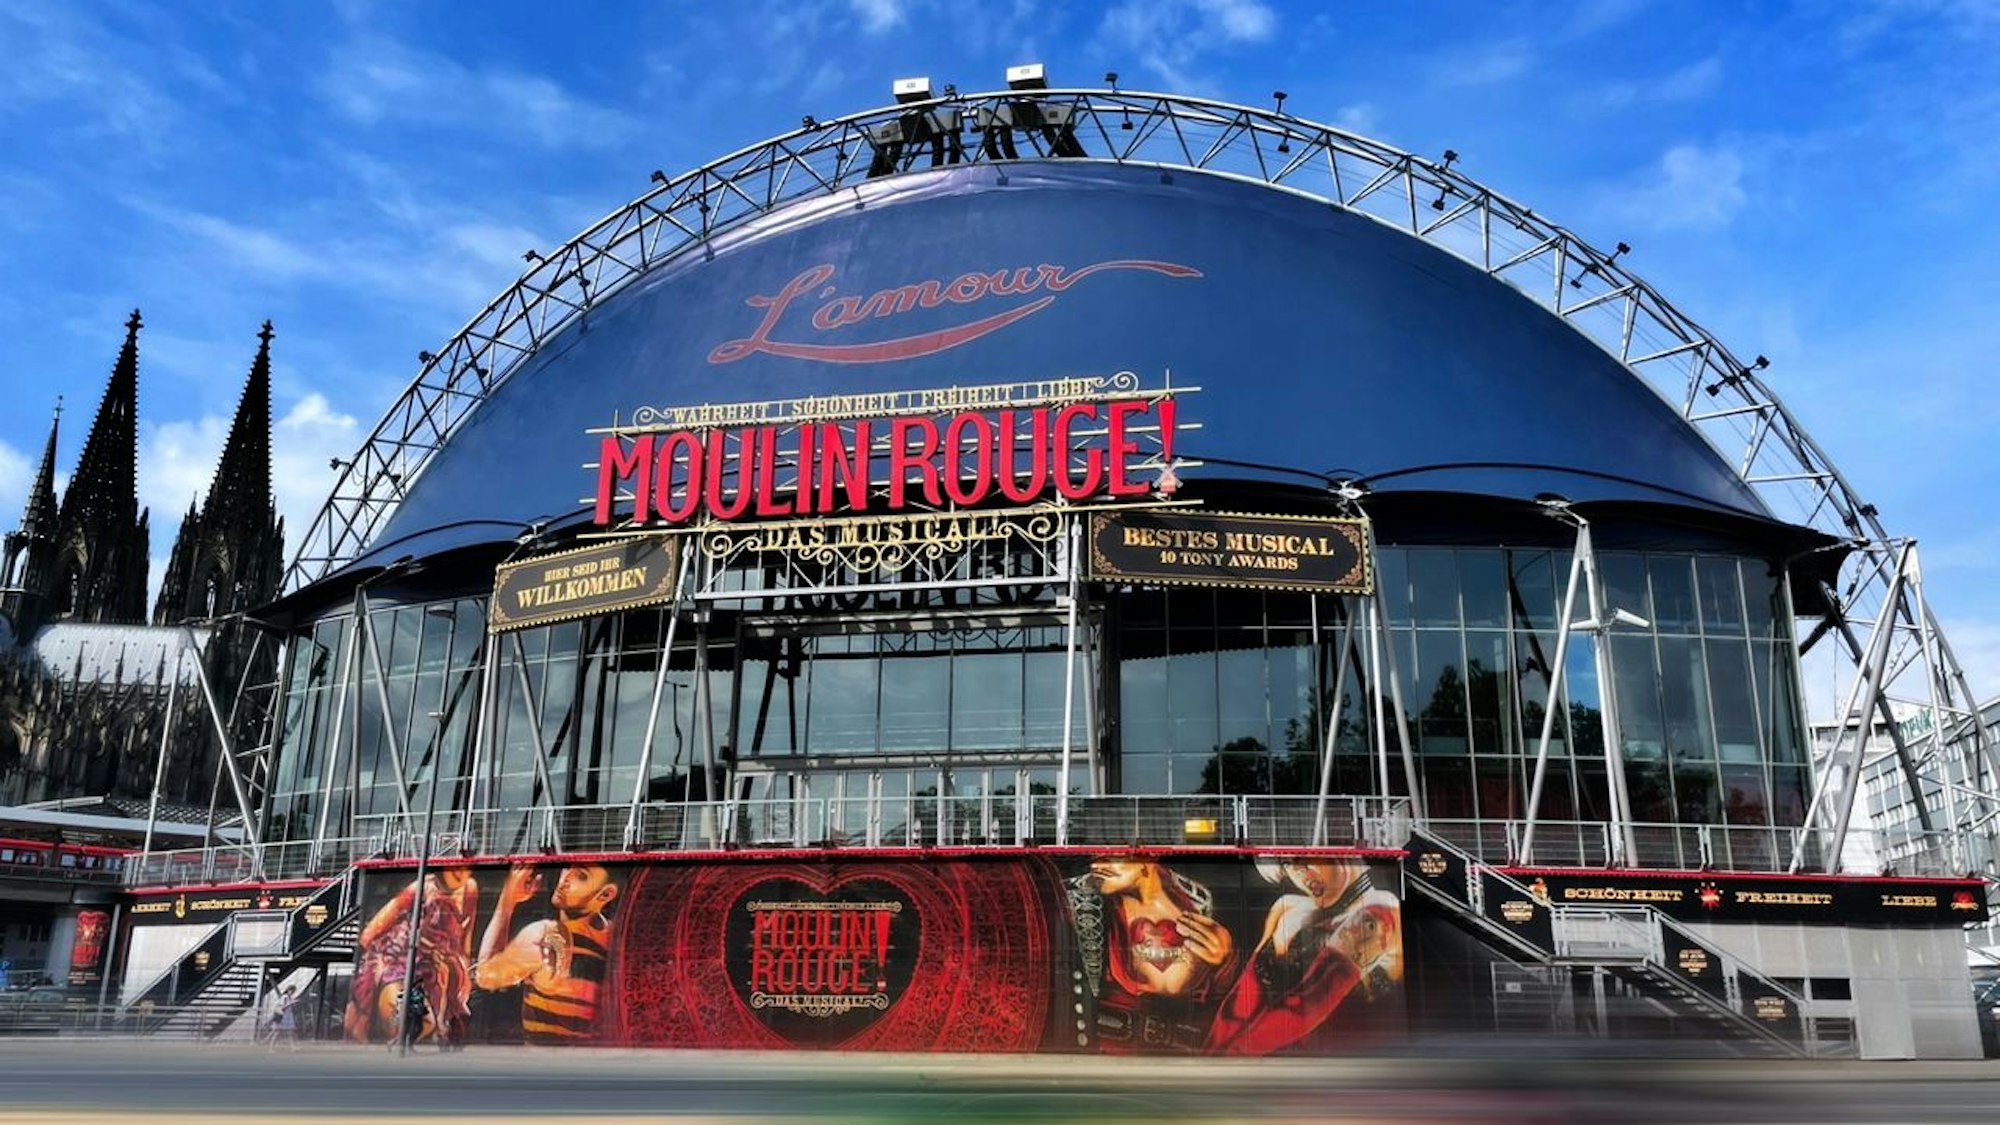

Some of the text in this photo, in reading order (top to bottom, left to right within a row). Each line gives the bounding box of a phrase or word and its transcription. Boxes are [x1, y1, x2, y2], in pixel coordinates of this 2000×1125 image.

[707, 260, 1203, 364] L'amour
[672, 402, 769, 424] WAHRHEIT
[792, 393, 898, 415] SCHÖNHEIT
[921, 386, 1013, 406] FREIHEIT
[594, 399, 1182, 526] MOULIN ROUGE!
[766, 515, 999, 549] DAS MUSICAL!
[1123, 527, 1334, 556] BESTES MUSICAL
[544, 557, 621, 582] HIER SEID IHR
[1160, 550, 1299, 570] 10 TONY AWARDS
[516, 566, 648, 609] WILLKOMMEN
[1564, 887, 1684, 901] SCHÖNHEIT
[1735, 891, 1833, 905] FREIHEIT
[1881, 895, 1938, 907] LIEBE
[754, 911, 872, 950] MOULIN
